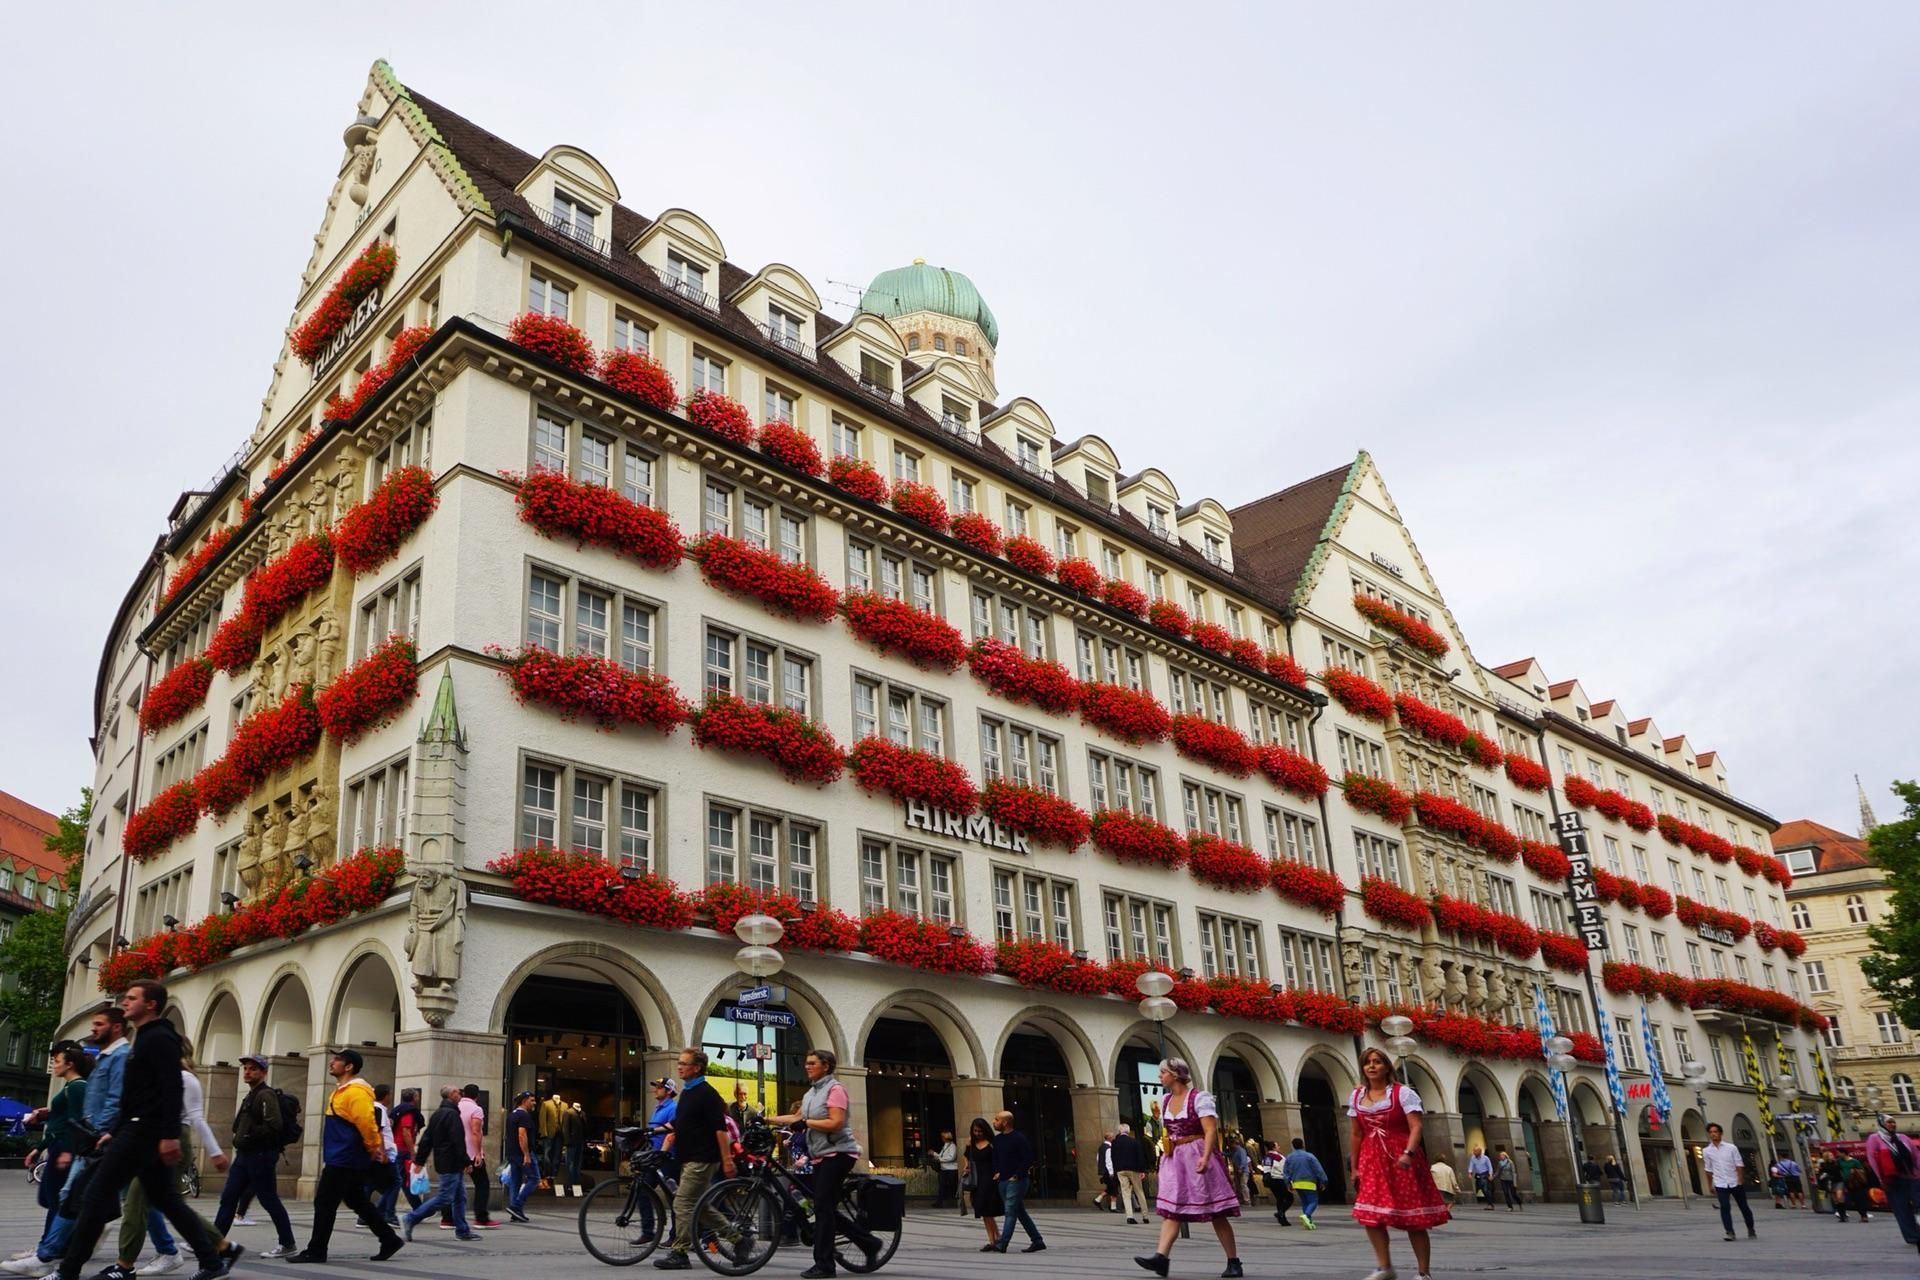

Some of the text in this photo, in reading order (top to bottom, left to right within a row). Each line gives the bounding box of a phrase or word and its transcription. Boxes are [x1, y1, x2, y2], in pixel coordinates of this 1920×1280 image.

[313, 287, 379, 380] HIRMER
[906, 798, 1030, 854] HIRMER
[1560, 813, 1602, 949] HIRMER
